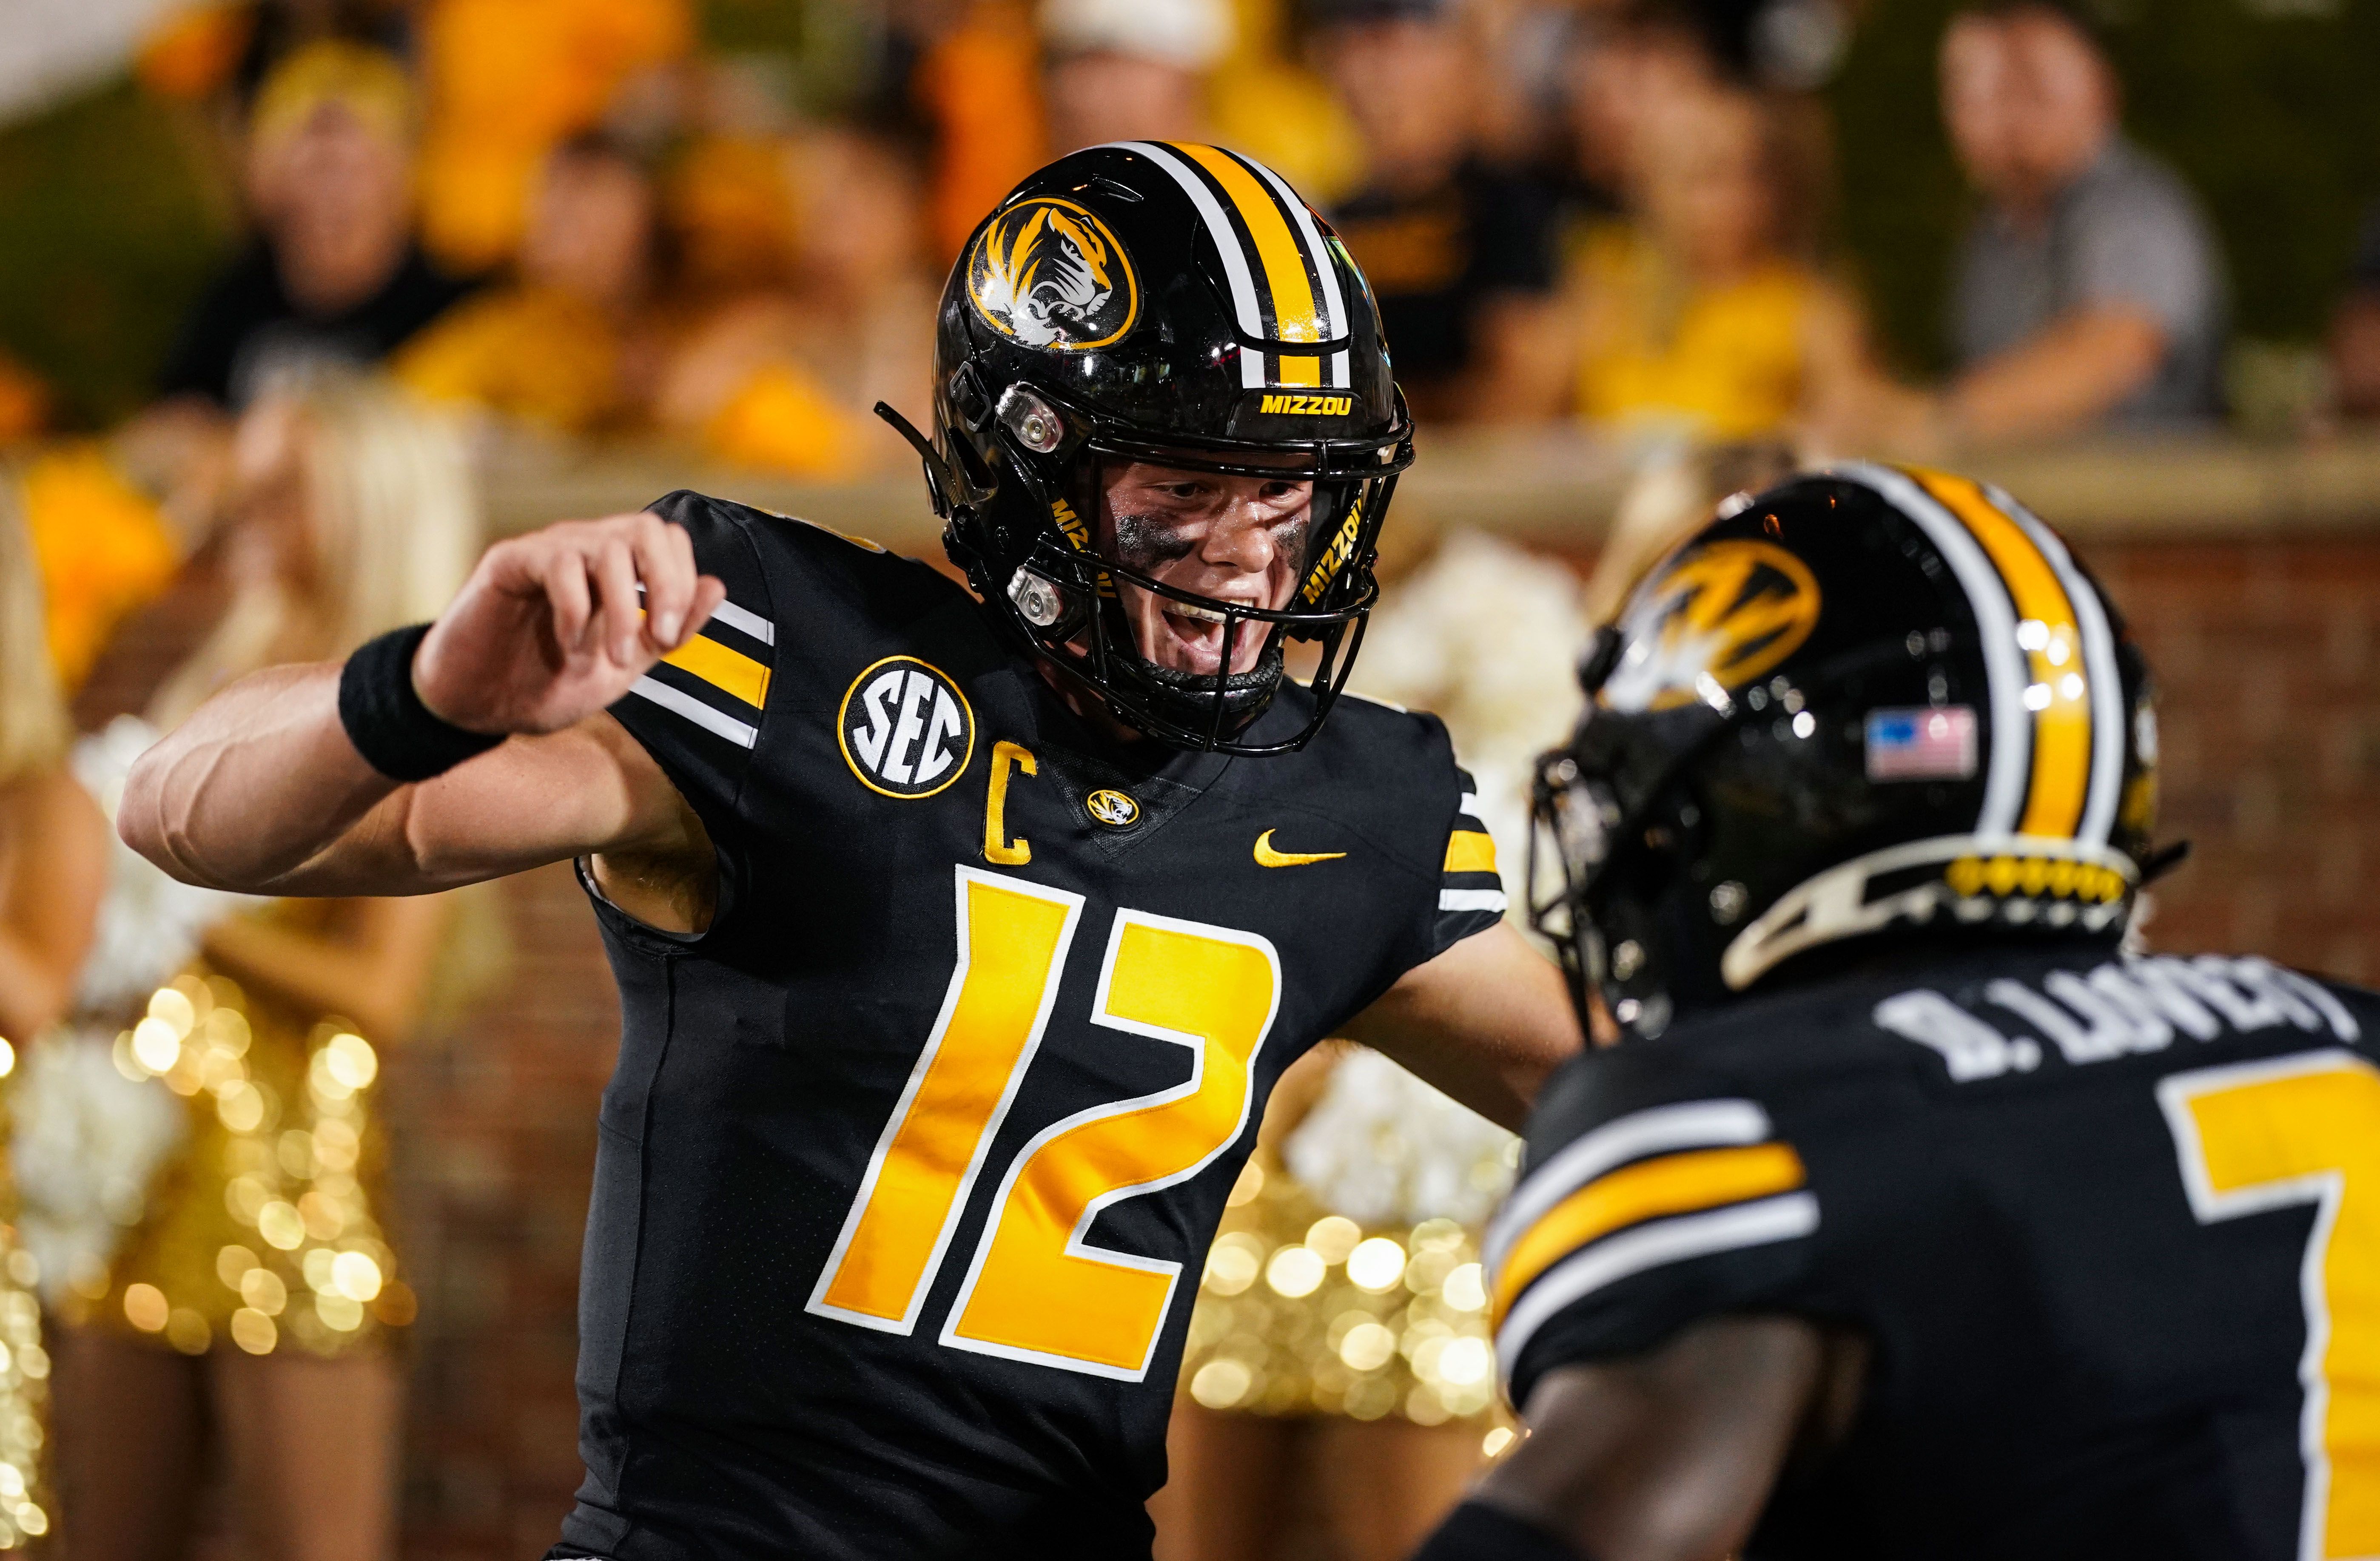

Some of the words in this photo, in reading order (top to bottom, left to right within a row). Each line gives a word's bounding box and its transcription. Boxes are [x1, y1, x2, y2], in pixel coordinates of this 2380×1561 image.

[1259, 395, 1352, 416] MIZZOU
[1051, 497, 1117, 598] MIZU
[852, 669, 962, 785] SEC
[984, 740, 1038, 866] C
[805, 863, 1282, 1383] 12
